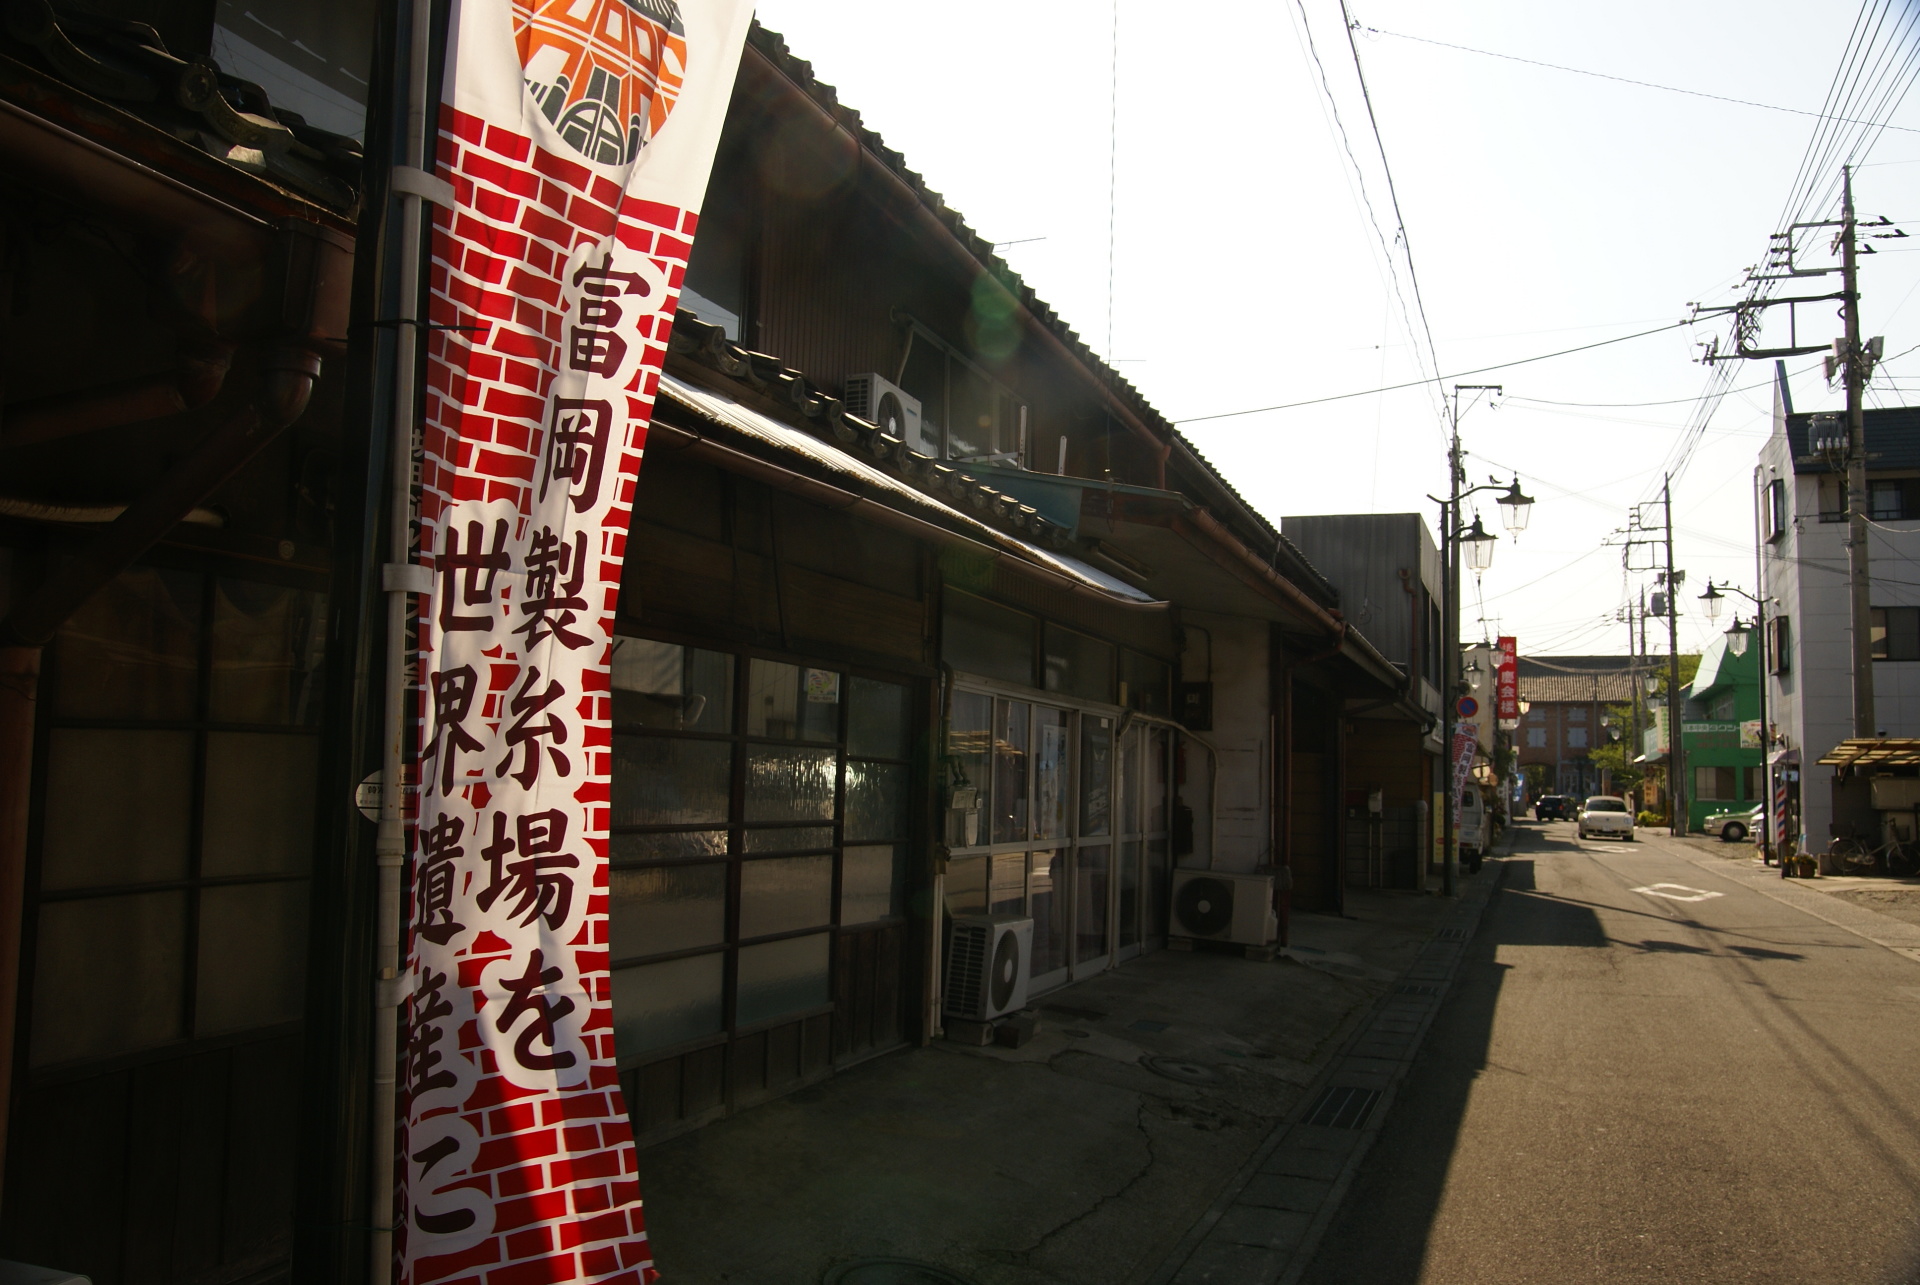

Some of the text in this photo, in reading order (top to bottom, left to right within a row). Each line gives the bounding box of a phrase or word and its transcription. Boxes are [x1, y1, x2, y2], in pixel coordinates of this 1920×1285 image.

[476, 253, 651, 1070] 富岡製糸場を
